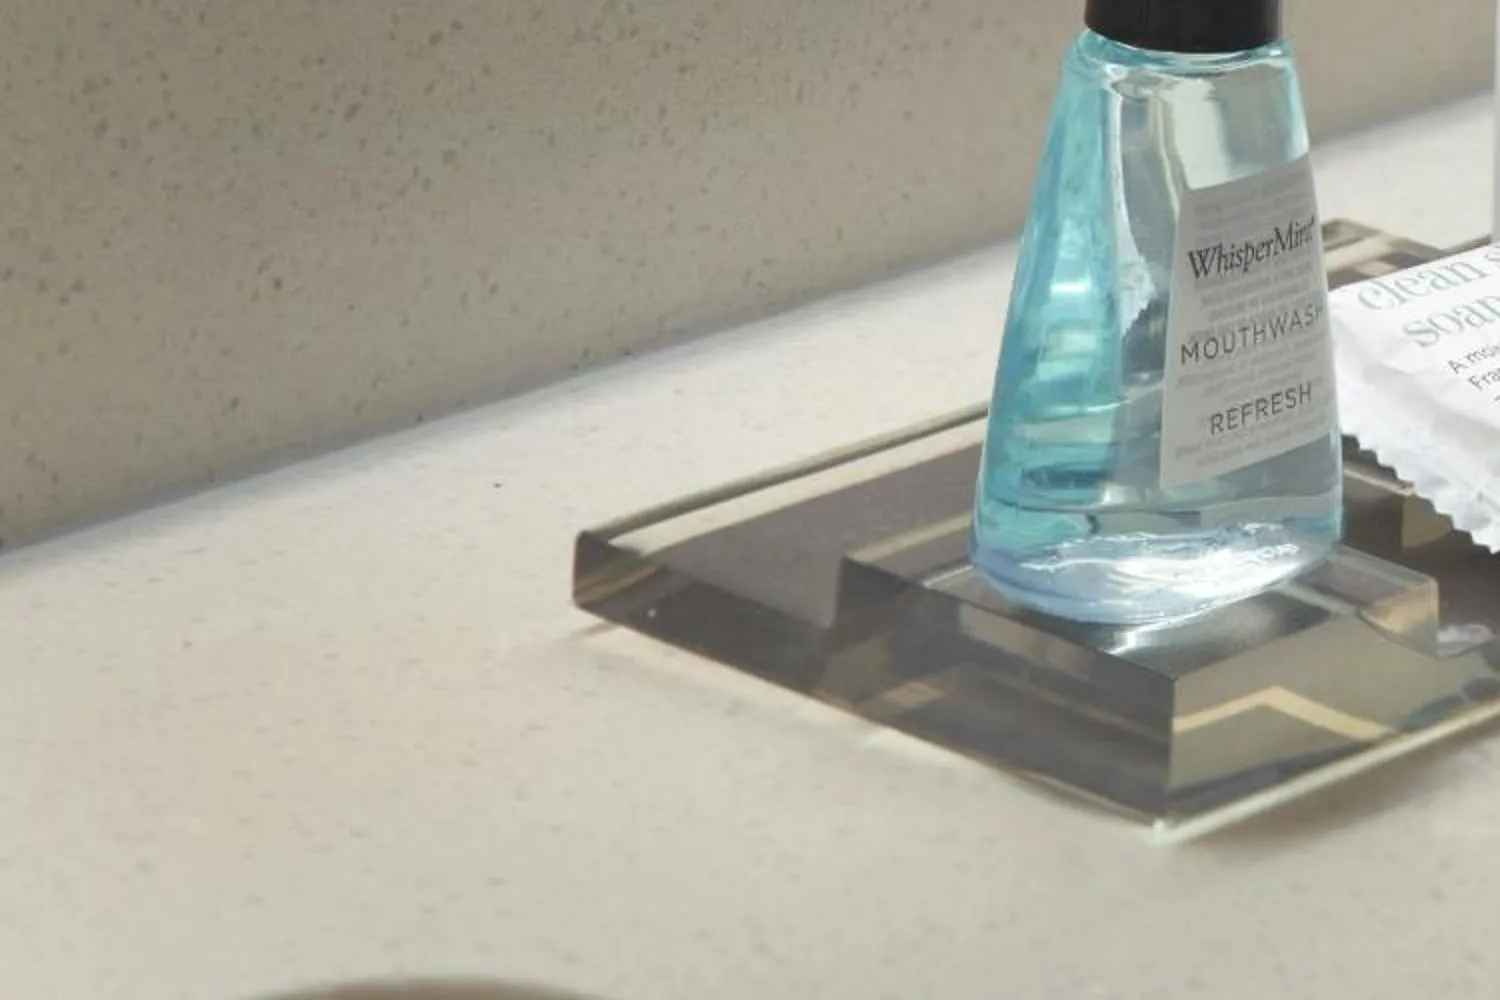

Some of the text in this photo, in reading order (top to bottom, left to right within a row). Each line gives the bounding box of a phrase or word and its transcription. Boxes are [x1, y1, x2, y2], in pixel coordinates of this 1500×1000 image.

[1357, 261, 1490, 310] clean
[1447, 360, 1469, 375] A
[1210, 381, 1312, 436] REFRESH
